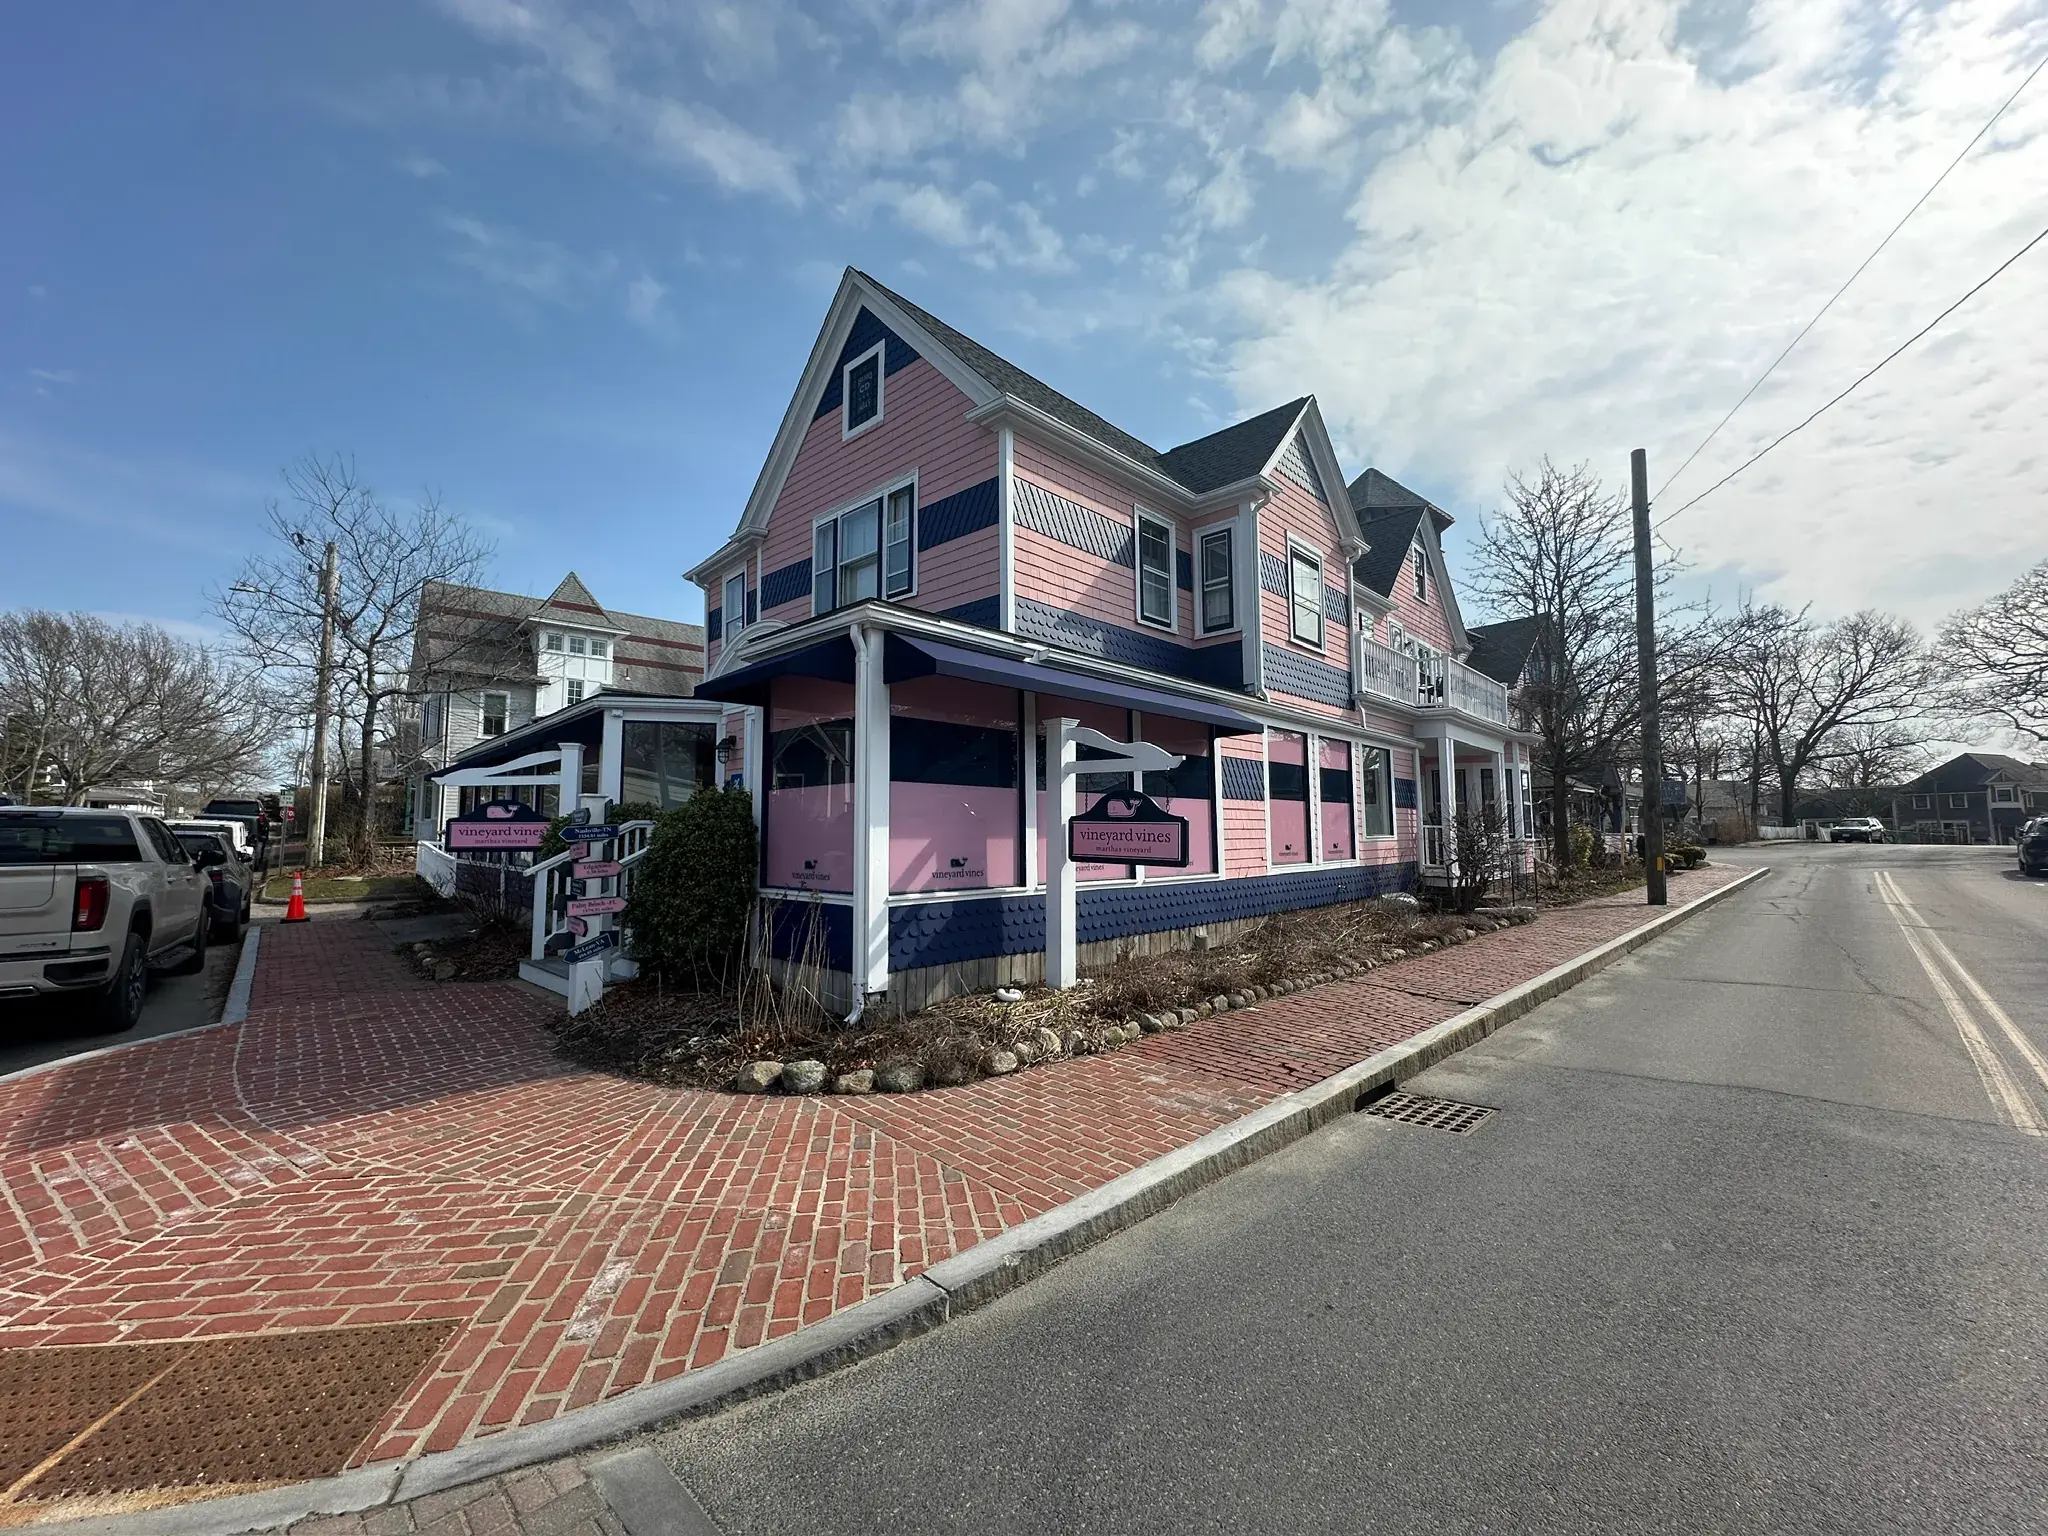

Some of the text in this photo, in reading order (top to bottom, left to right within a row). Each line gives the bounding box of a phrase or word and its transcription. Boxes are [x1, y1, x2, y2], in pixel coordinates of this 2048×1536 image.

[459, 826, 545, 838] vineyard vines
[1080, 828, 1171, 845] vineyard vines
[1123, 846, 1152, 855] vineyard
[1075, 863, 1104, 872] eyard vines
[792, 871, 830, 881] vineyard vines
[932, 869, 985, 879] vineyard vines
